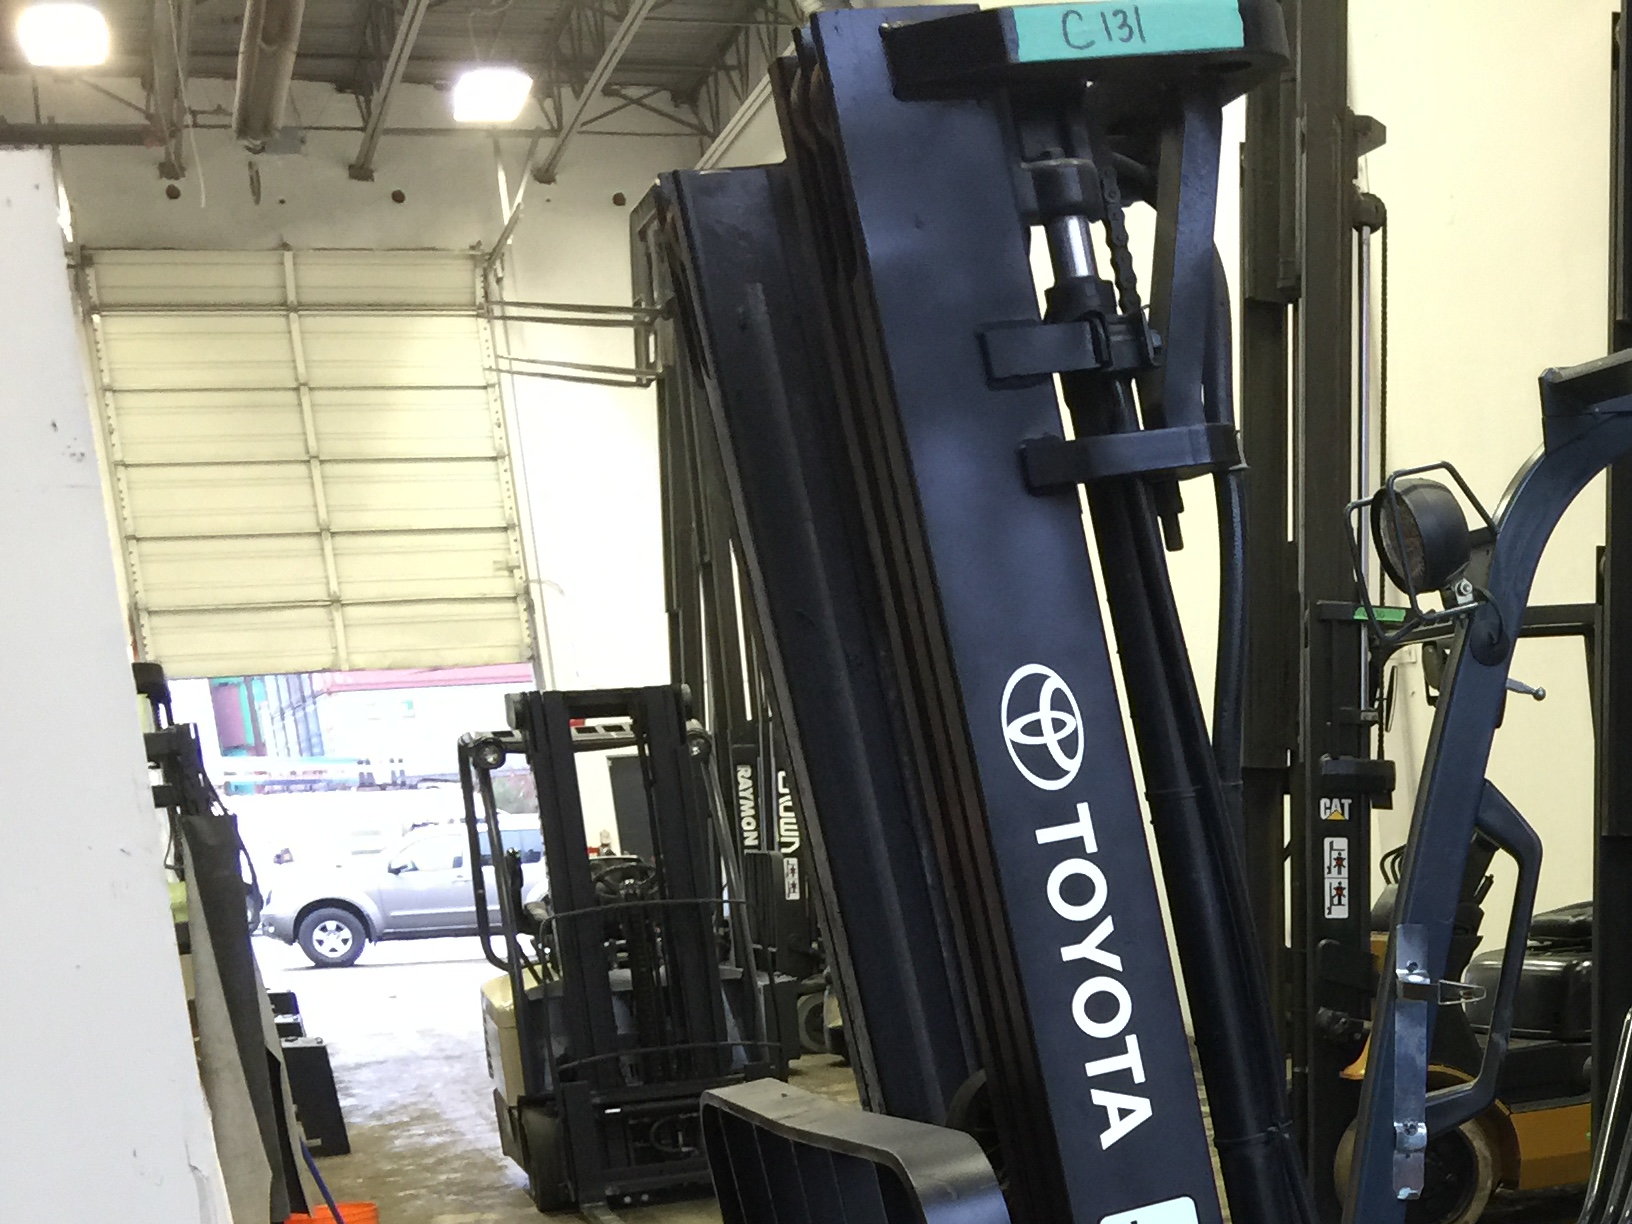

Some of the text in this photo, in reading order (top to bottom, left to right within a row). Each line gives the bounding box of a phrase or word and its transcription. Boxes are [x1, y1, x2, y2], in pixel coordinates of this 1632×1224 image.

[1061, 5, 1146, 50] C131
[737, 764, 759, 855] RAYMON
[1319, 797, 1353, 821] CAT
[1035, 802, 1153, 1151] TOYOTA
